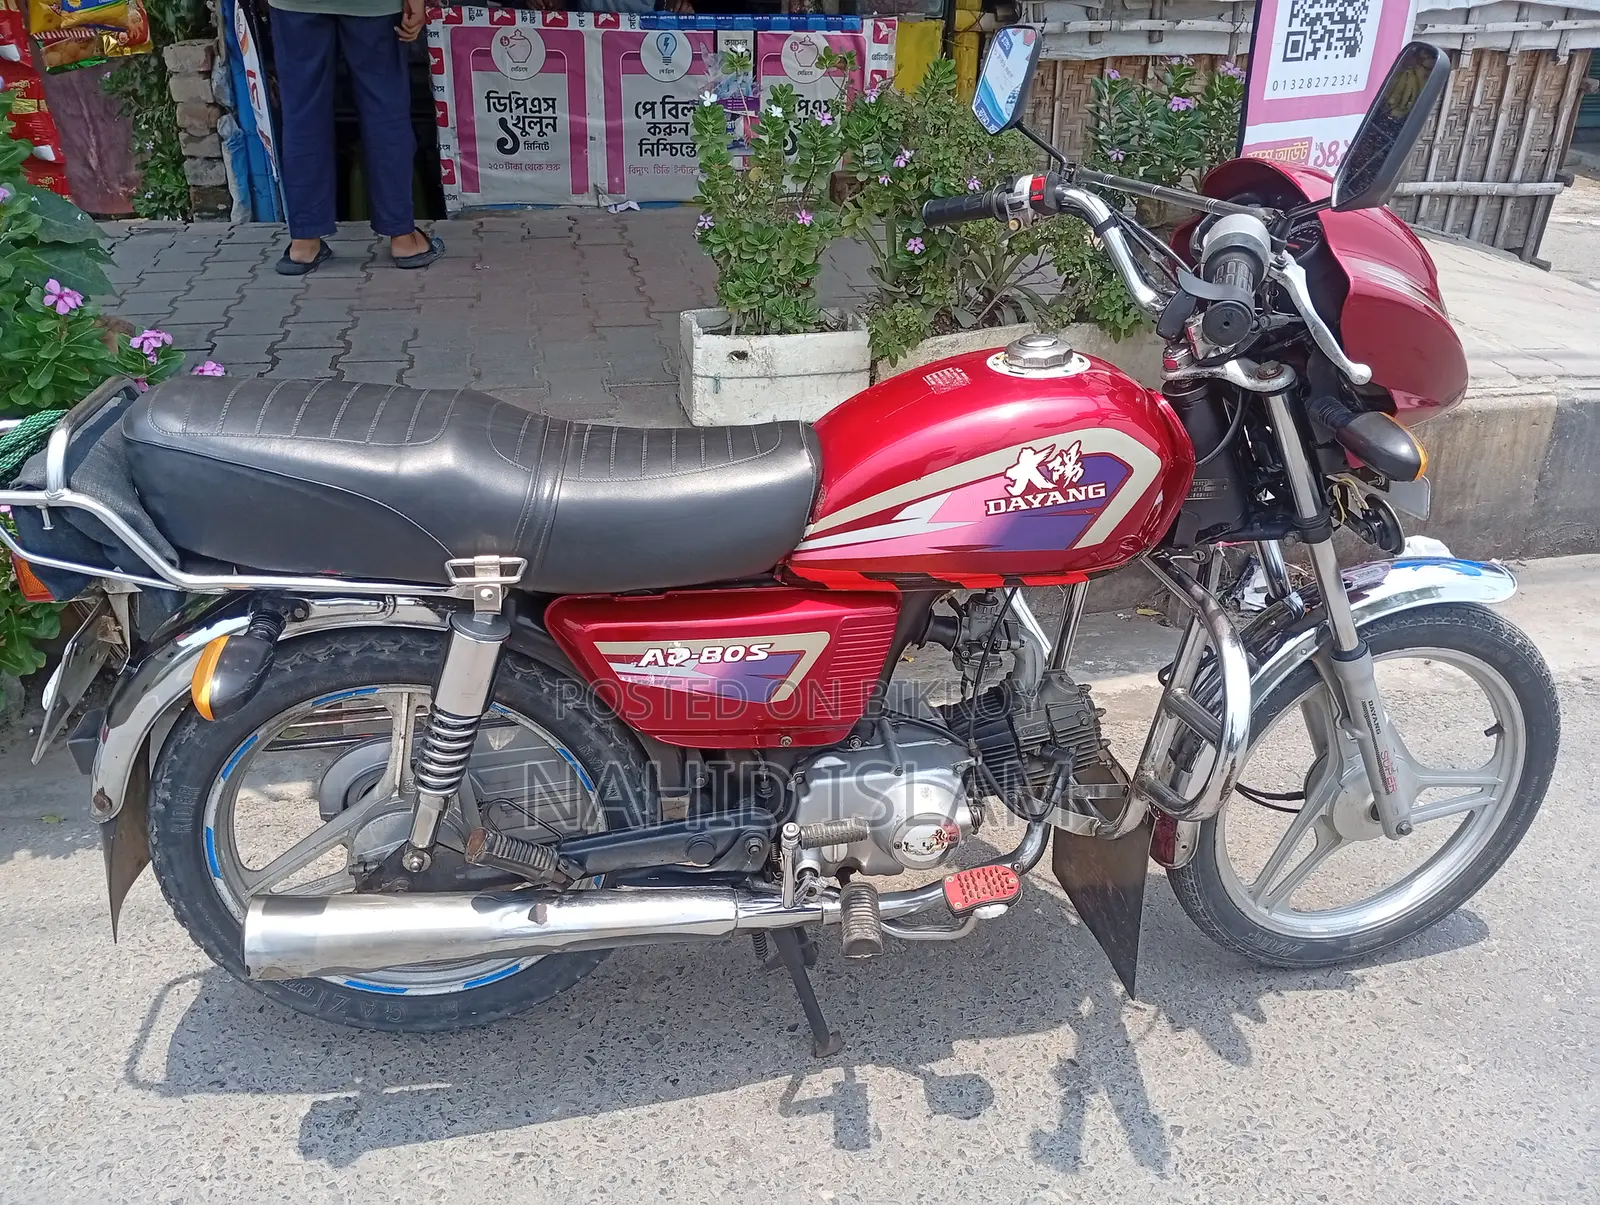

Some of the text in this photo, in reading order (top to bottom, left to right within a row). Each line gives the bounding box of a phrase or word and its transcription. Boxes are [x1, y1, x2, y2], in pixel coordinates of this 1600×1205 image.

[1272, 74, 1359, 91] 01328272324
[485, 90, 557, 114] ডিপিএস
[634, 100, 657, 119] পে
[496, 117, 520, 155] ১
[511, 115, 558, 137] খুলুন
[646, 122, 690, 136] করুন
[523, 141, 550, 151] মিনিটে
[638, 138, 697, 157] নিশ্চিন্তে
[505, 161, 523, 171] টাকা
[525, 162, 544, 171] থেকে
[545, 162, 561, 172] শুরু
[985, 483, 1106, 516] DAYANG
[1368, 700, 1382, 735] DAYANG
[1380, 750, 1397, 793] SUPER
